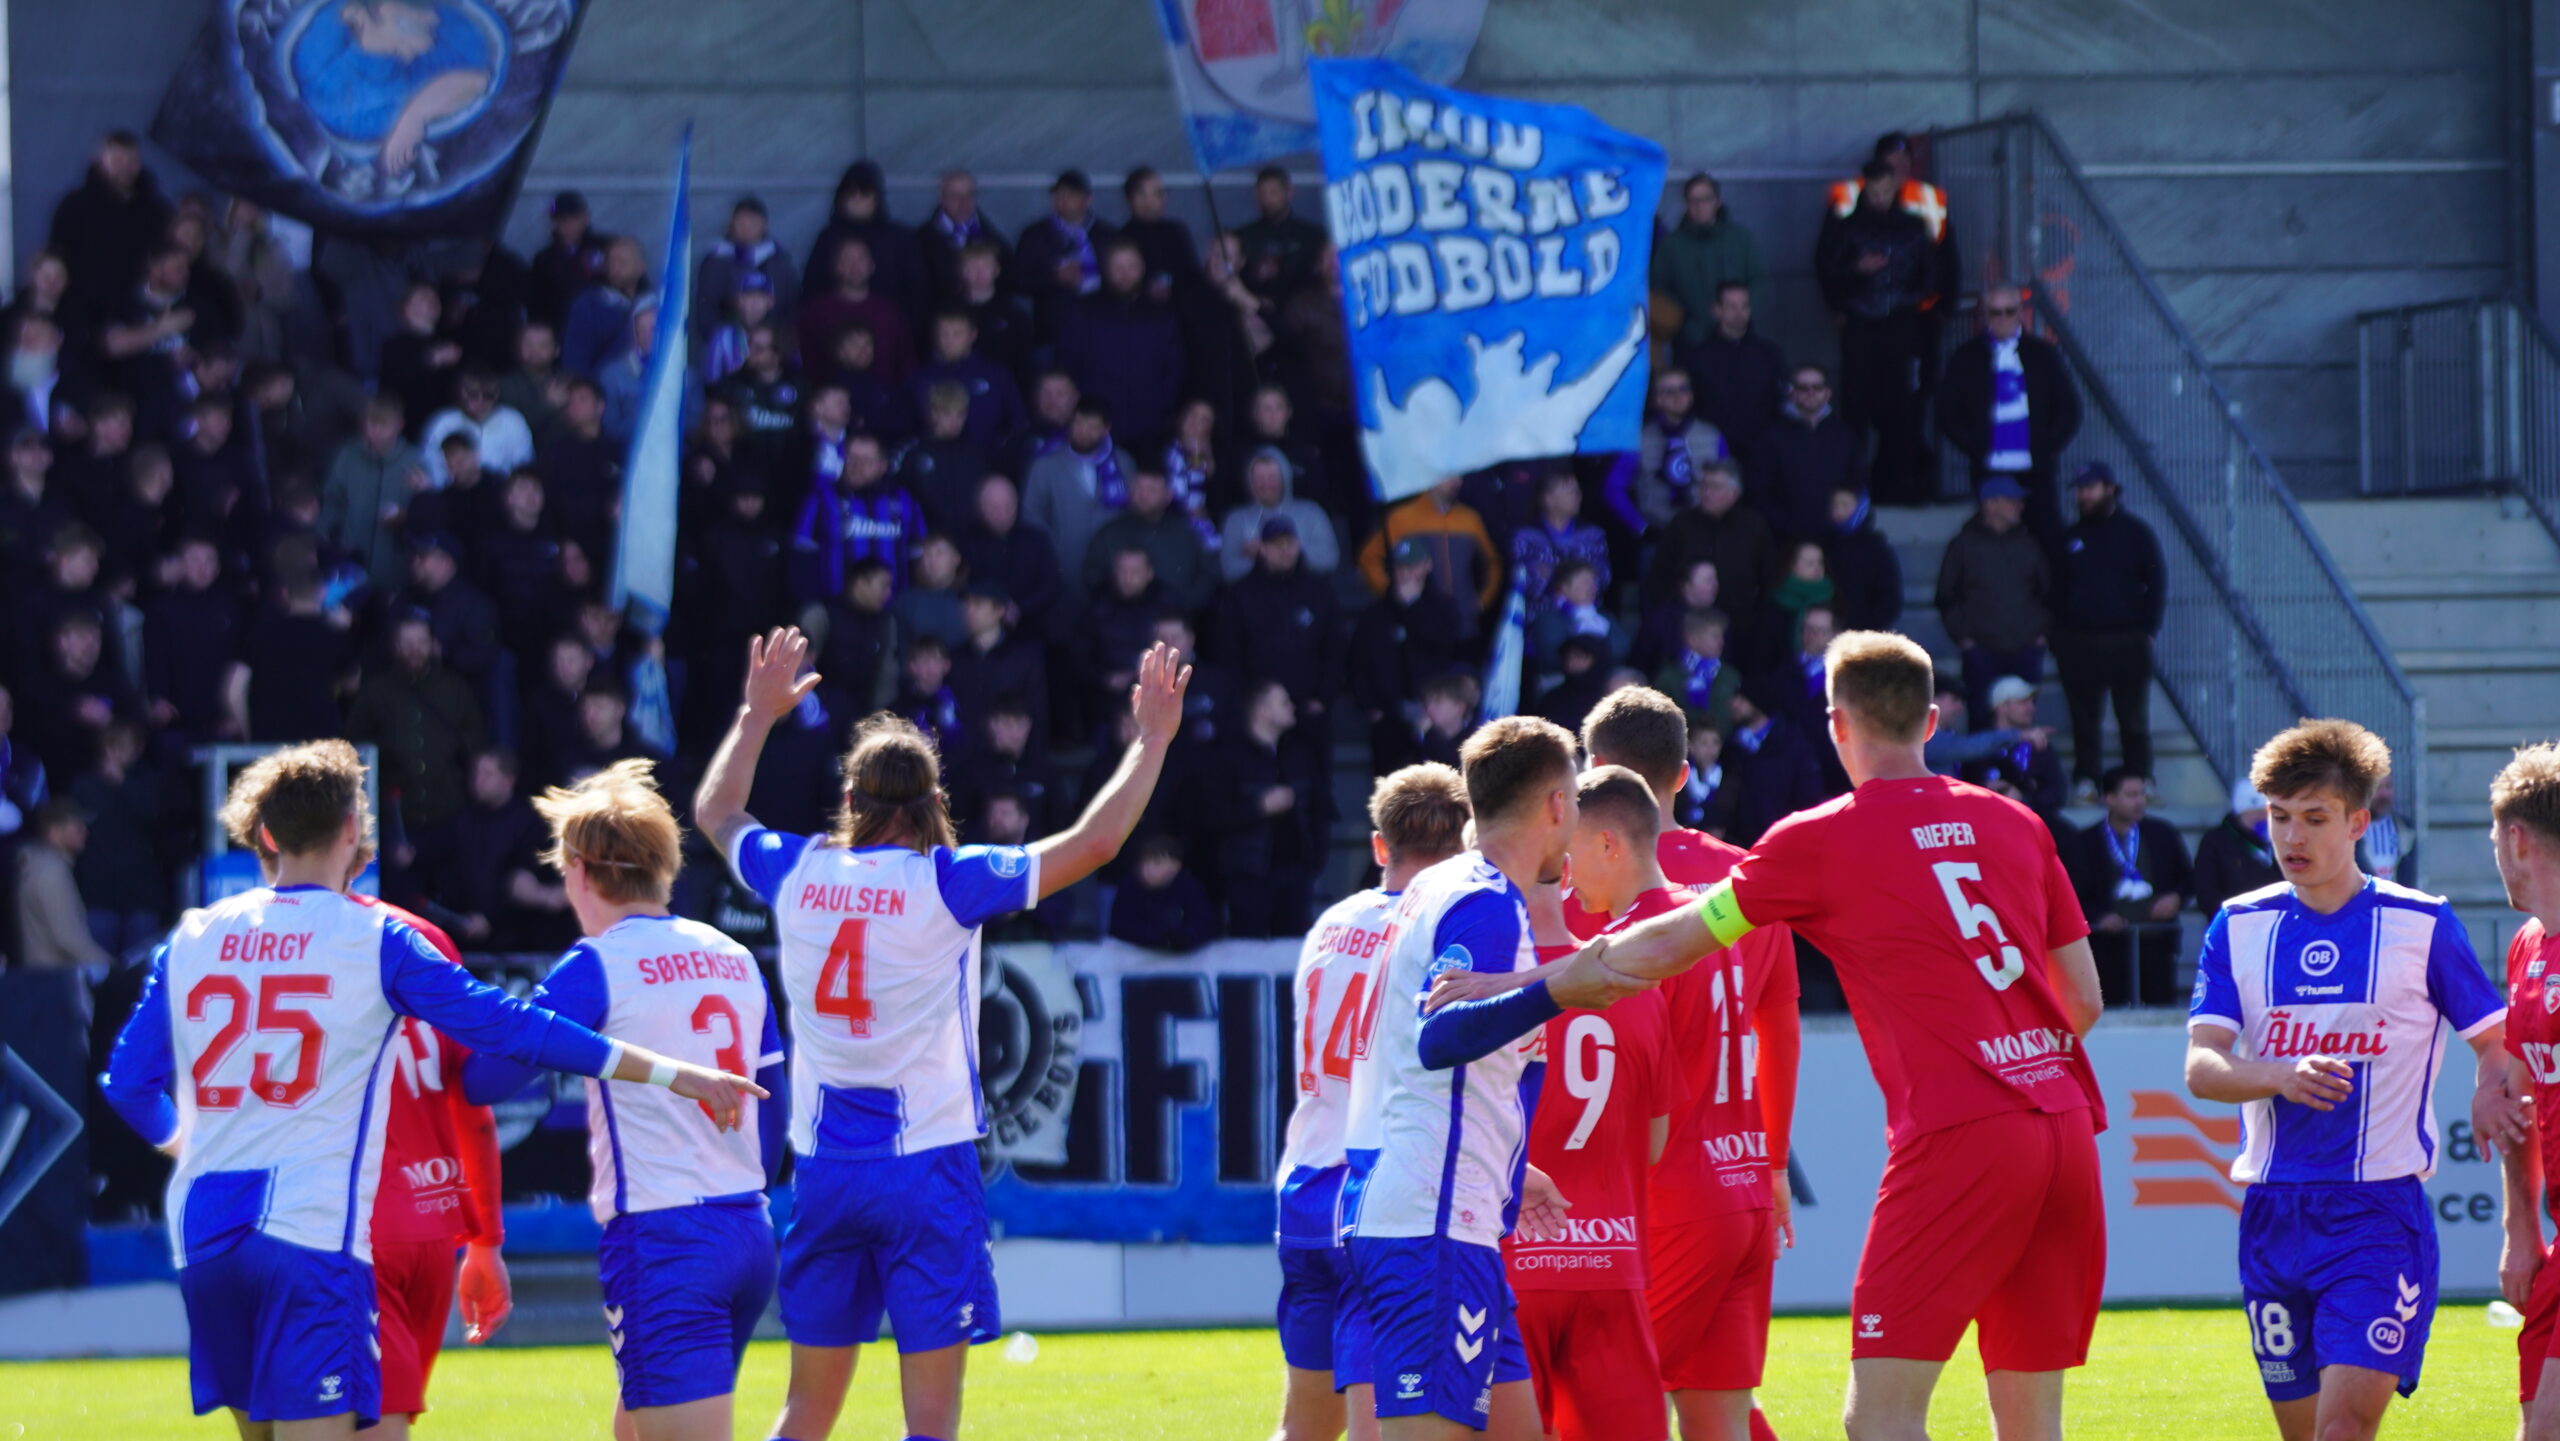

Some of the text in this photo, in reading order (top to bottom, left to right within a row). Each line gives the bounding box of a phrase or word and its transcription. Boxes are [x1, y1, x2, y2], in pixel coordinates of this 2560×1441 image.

[1351, 229, 1620, 329] FODBOLD
[1911, 822, 1976, 850] RIEPER
[800, 883, 906, 916] PAULSEN
[219, 927, 315, 962] BÜRGY
[1931, 861, 2025, 991] 5
[638, 951, 752, 985] SØRENSEN
[2307, 950, 2332, 965] OB
[815, 918, 876, 1038] 4
[2307, 983, 2344, 995] hummel
[186, 973, 335, 1112] 25
[1977, 1027, 2077, 1065] MOKONI
[2259, 1014, 2389, 1057] Albani
[690, 994, 749, 1126] 3
[1564, 1014, 1616, 1150] 9
[2447, 1119, 2482, 1162] &
[2428, 1192, 2496, 1222] ce
[1515, 1252, 1613, 1272] companies
[2249, 1300, 2295, 1356] 18
[2374, 1326, 2400, 1345] OB
